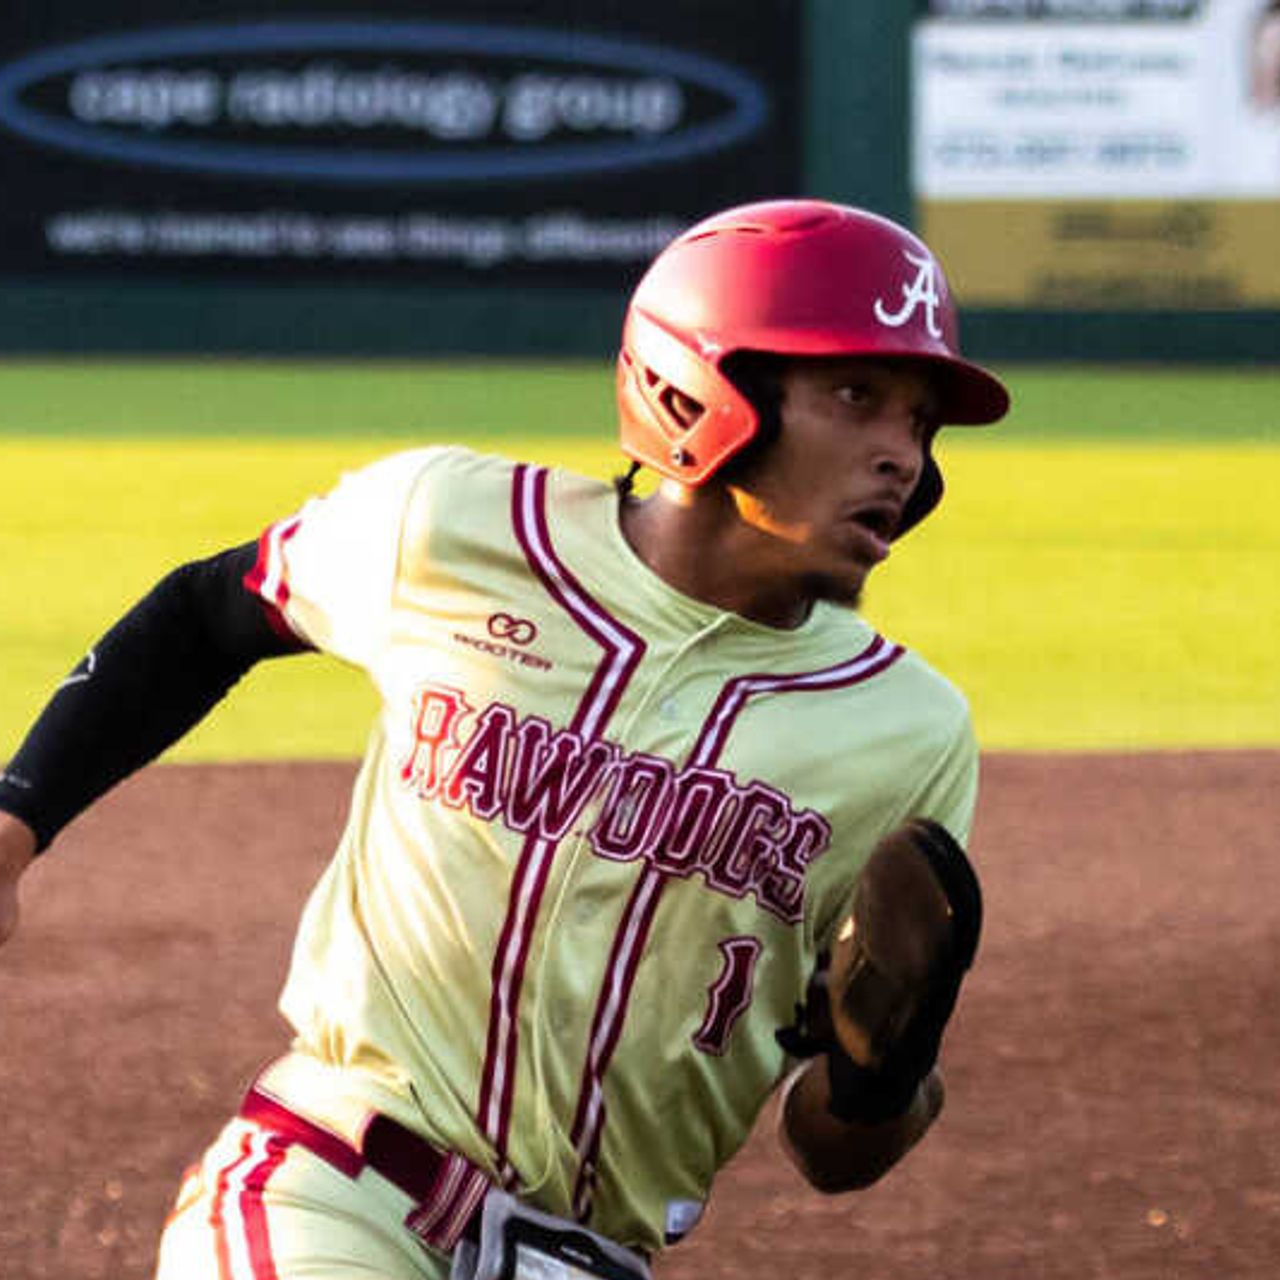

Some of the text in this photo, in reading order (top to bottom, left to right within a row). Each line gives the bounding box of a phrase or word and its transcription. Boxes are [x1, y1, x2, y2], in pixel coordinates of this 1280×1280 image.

[227, 67, 492, 138] radiology
[503, 74, 684, 138] group
[693, 936, 763, 1056] 1
